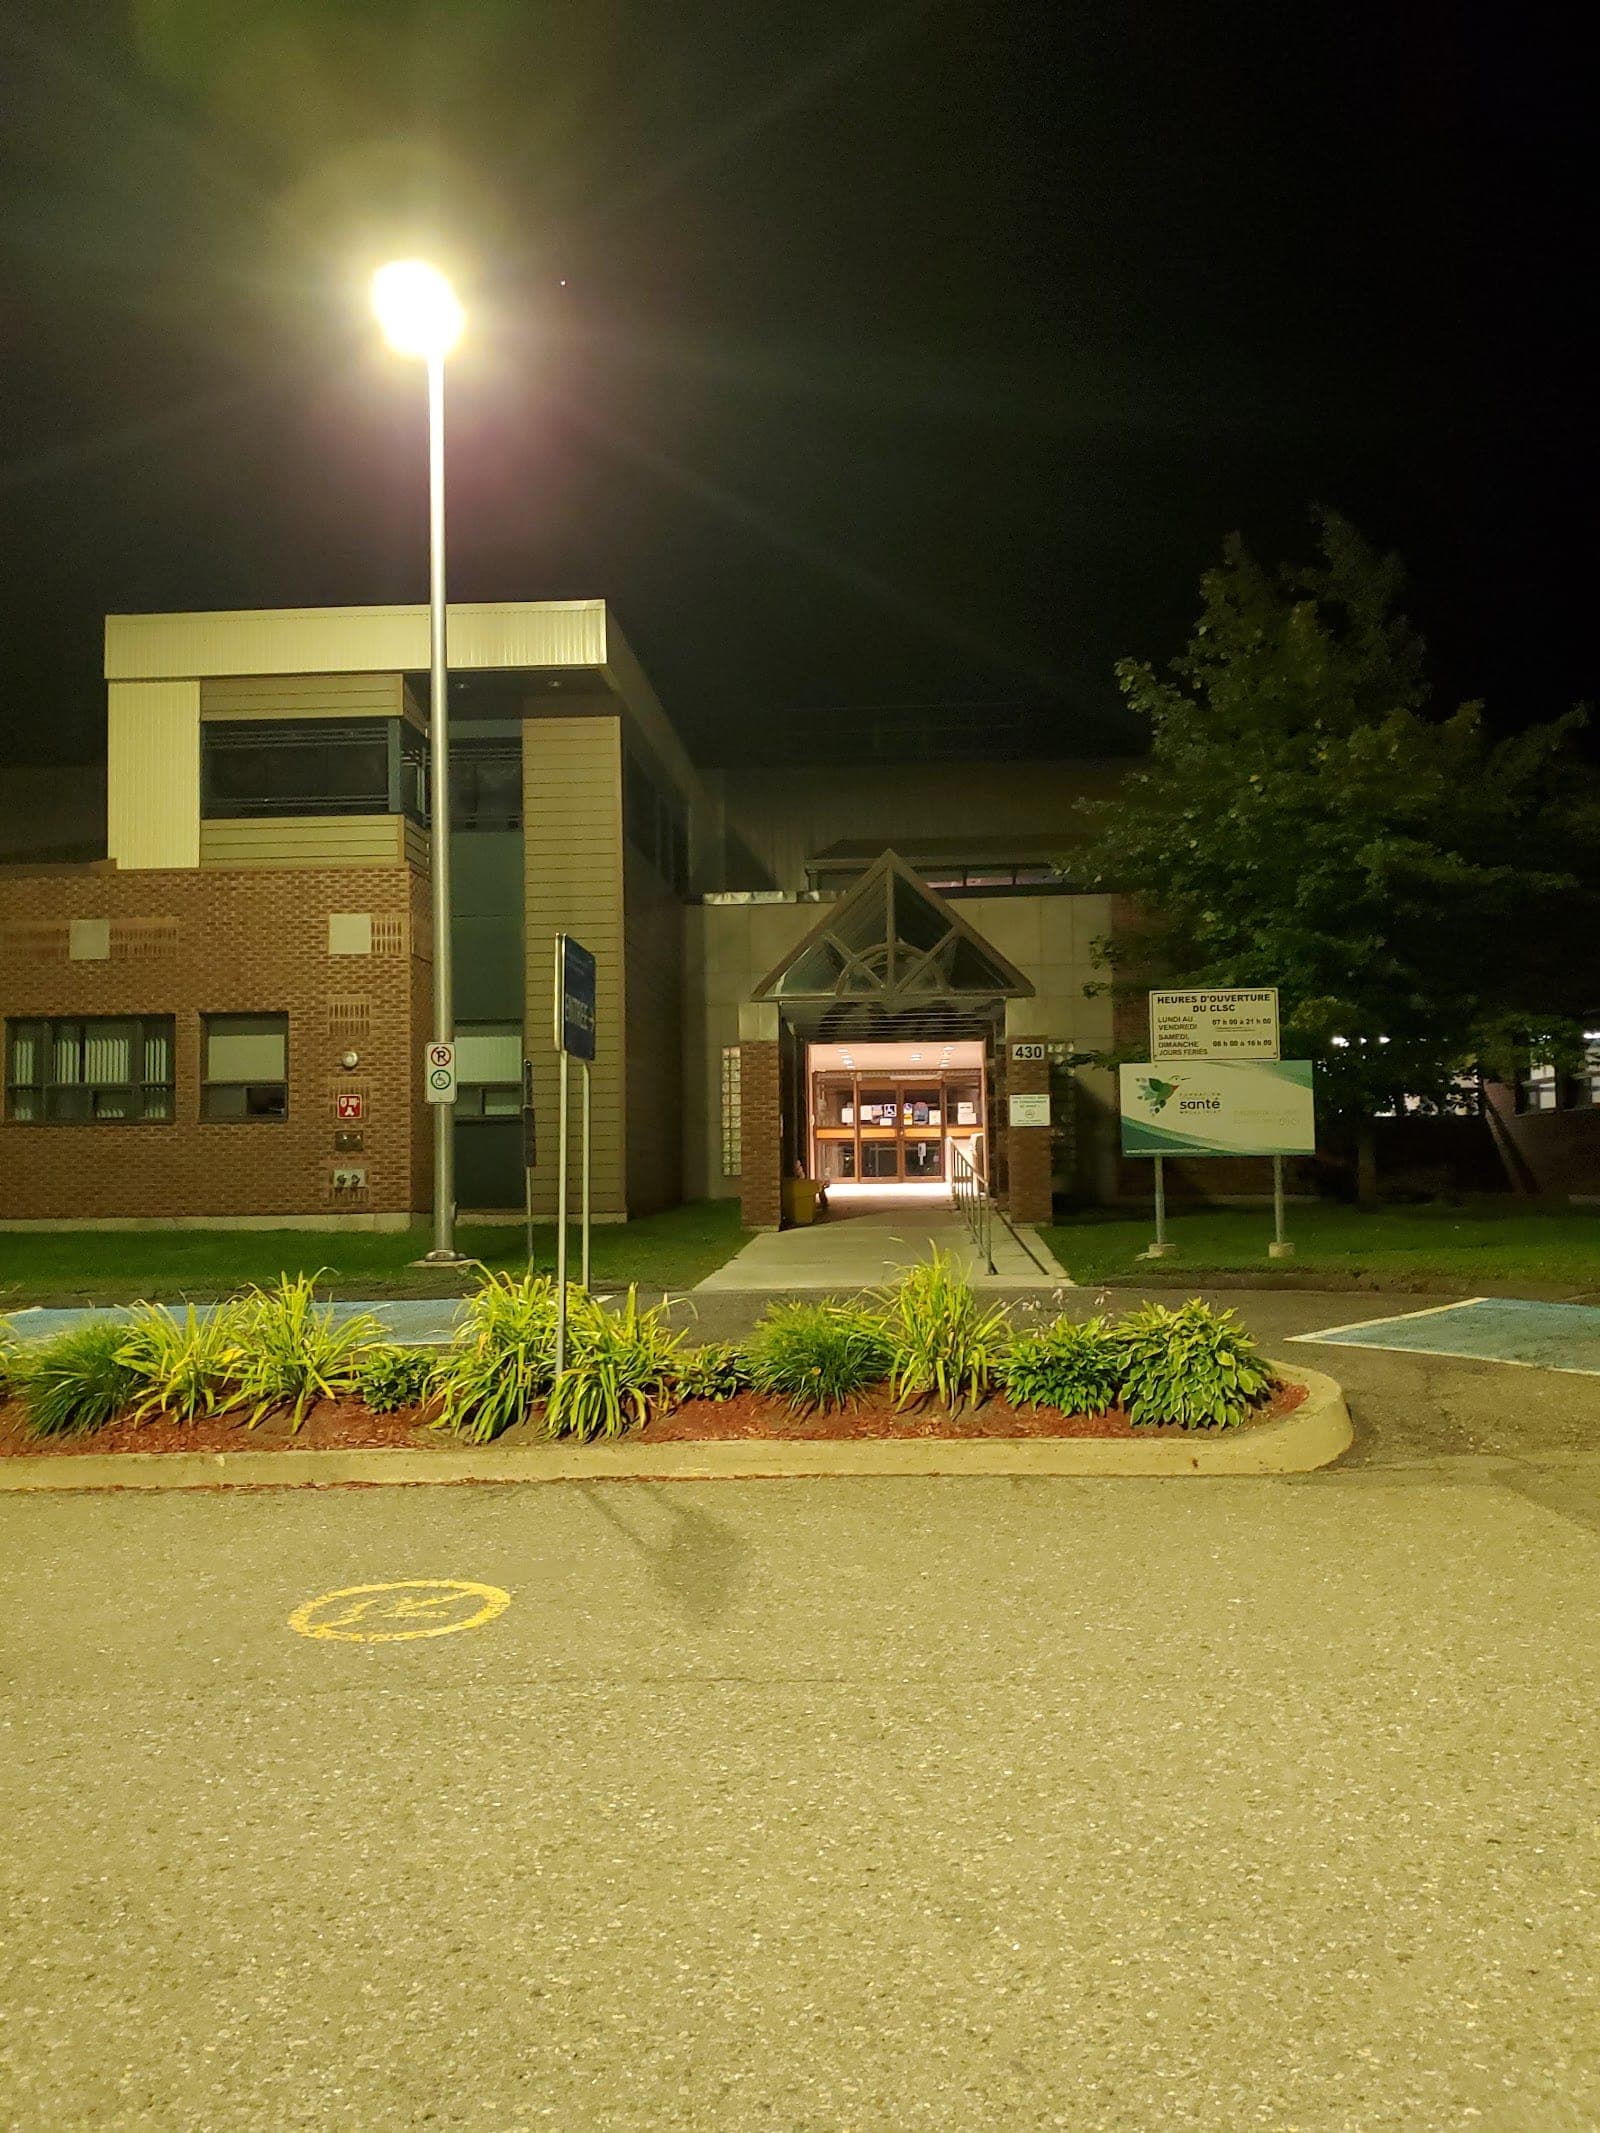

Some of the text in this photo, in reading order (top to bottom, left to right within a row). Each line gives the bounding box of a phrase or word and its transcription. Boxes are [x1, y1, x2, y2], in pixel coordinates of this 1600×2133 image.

[1157, 993, 1270, 1004] HEURES D'OUVERTURE
[1016, 1046, 1042, 1058] 430
[1179, 1097, 1220, 1110] santé
